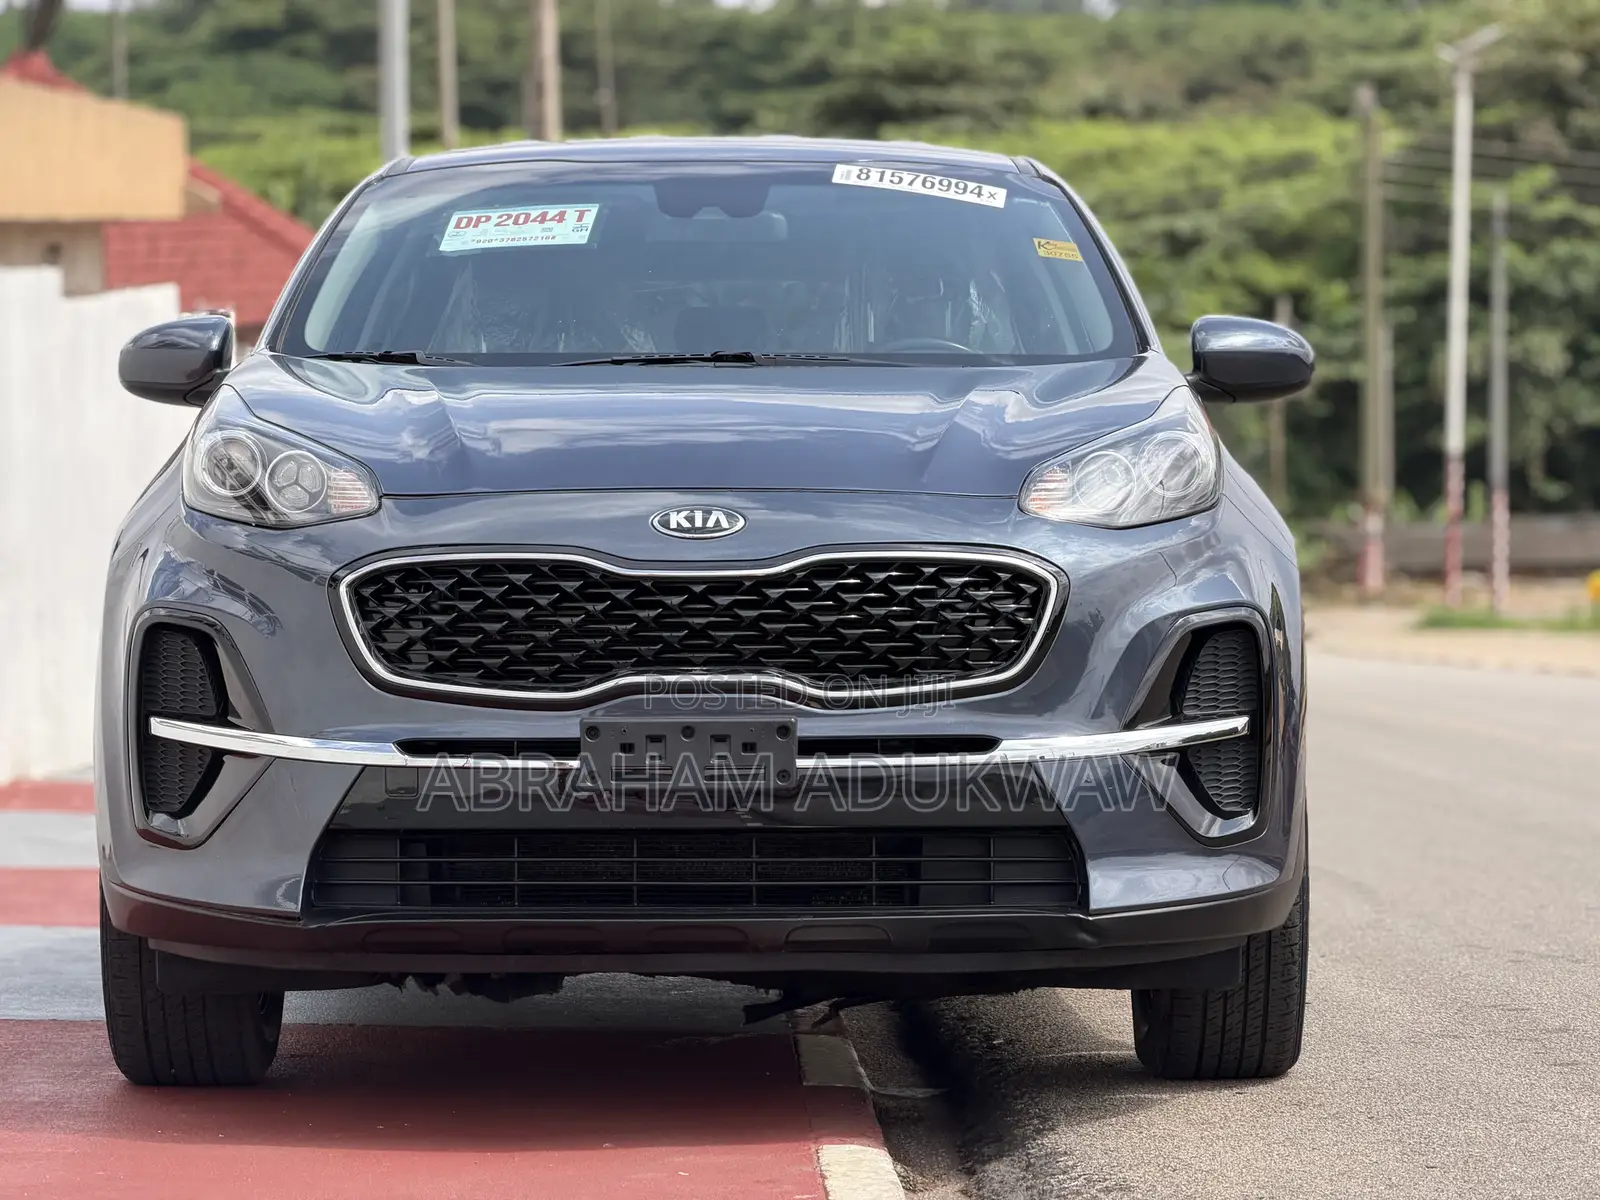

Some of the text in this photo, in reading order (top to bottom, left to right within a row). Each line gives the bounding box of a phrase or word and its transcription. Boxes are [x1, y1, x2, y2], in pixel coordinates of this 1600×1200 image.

[453, 209, 592, 230] DP 2044 T
[669, 510, 730, 529] KIA
